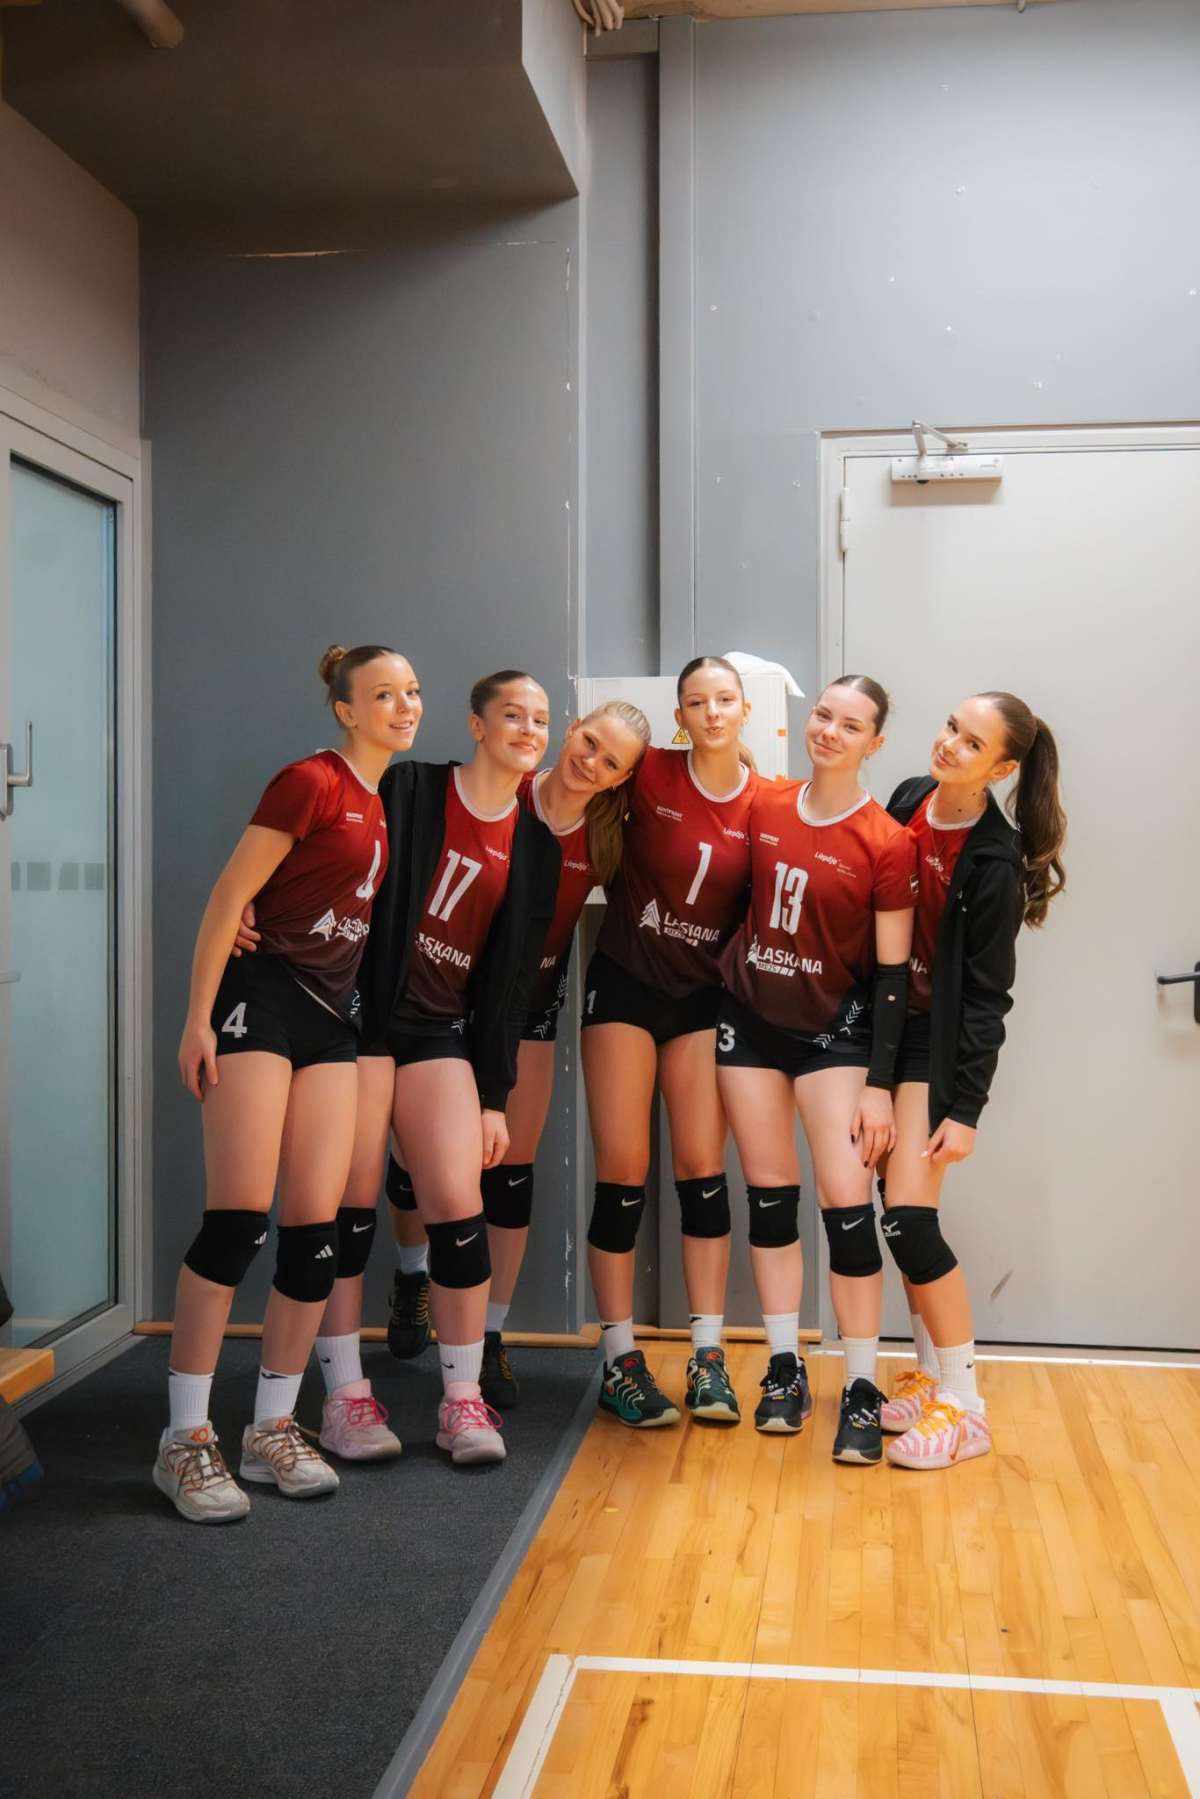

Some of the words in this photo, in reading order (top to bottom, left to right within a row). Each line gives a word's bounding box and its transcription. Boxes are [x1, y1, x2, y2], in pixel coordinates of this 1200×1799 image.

[427, 849, 483, 922] 17
[769, 861, 809, 936] 13
[757, 945, 822, 974] LASKANA
[221, 1002, 248, 1038] 4
[718, 1022, 735, 1052] 3
